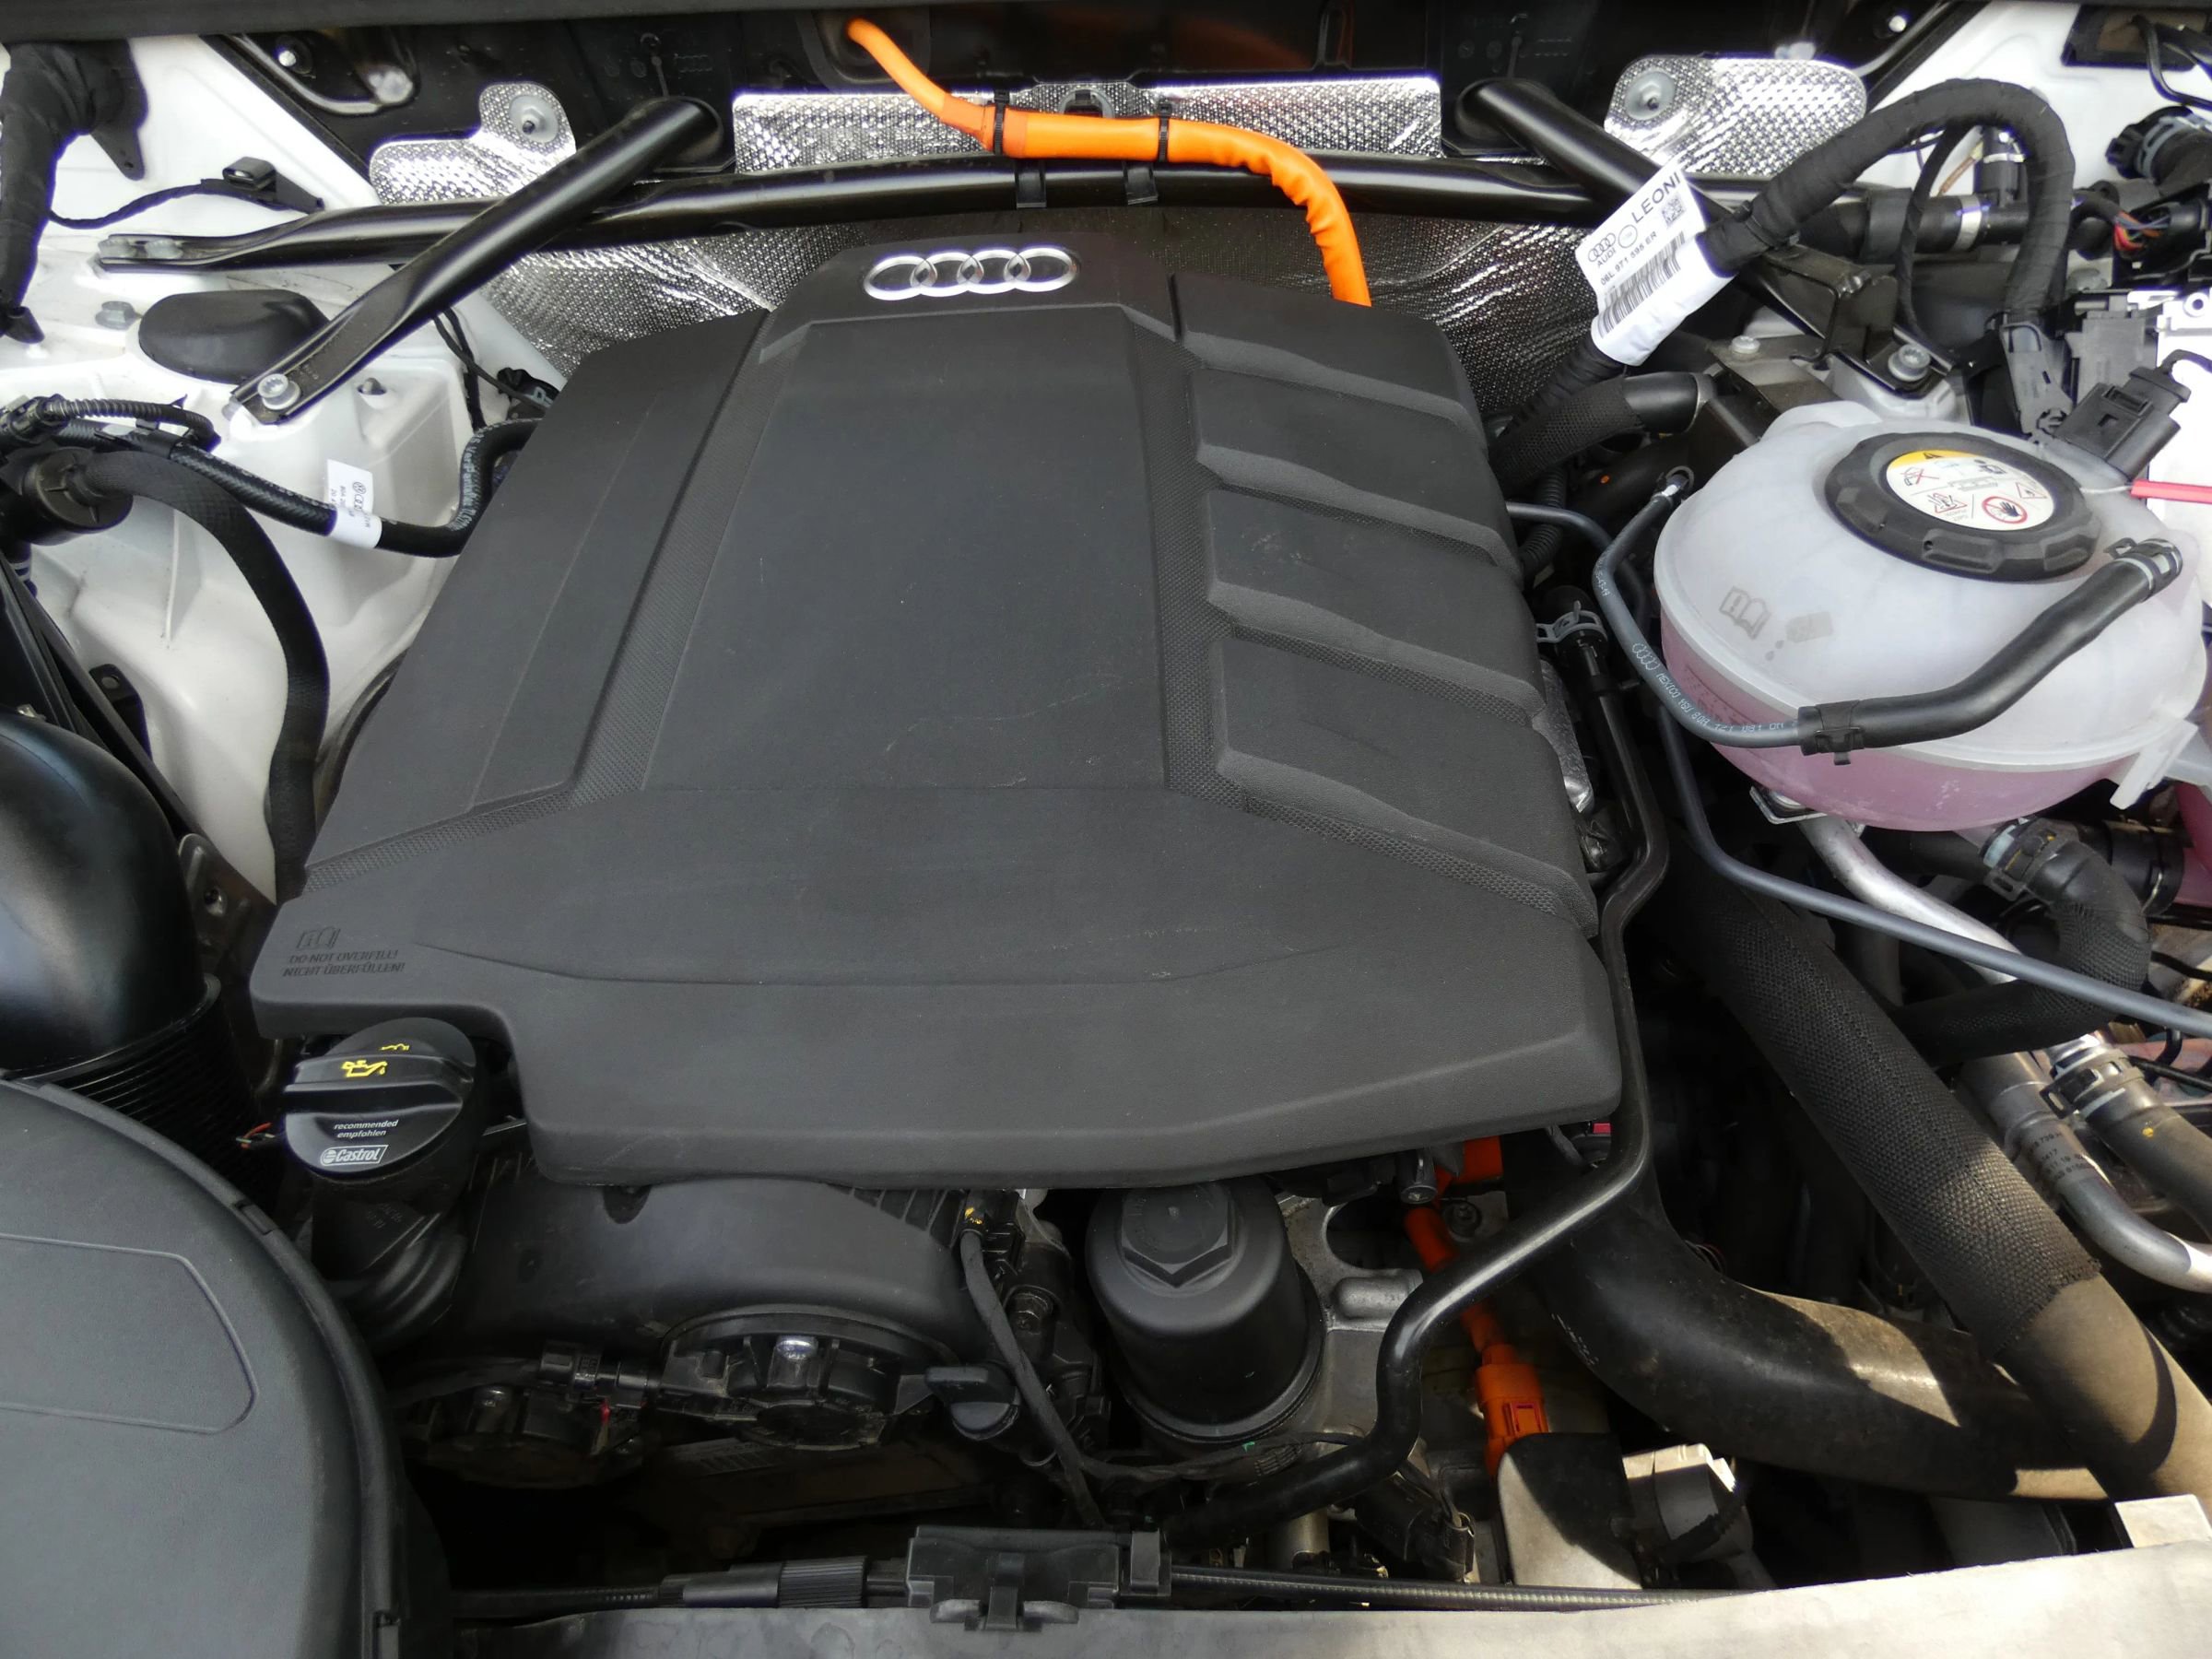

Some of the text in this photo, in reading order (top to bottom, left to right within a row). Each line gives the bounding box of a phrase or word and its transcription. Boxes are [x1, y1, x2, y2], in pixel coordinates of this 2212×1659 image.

[1631, 172, 1680, 223] LEONI
[1596, 249, 1617, 268] AUDI
[1656, 673, 1680, 699] MEXICO
[309, 952, 334, 963] NOT
[336, 949, 399, 962] OVERFILL!
[282, 961, 406, 977] NICHT ÜBERFÜLLEN!
[334, 1118, 399, 1130] recommended
[336, 1129, 387, 1139] empfohlen
[335, 1147, 381, 1162] Castrol
